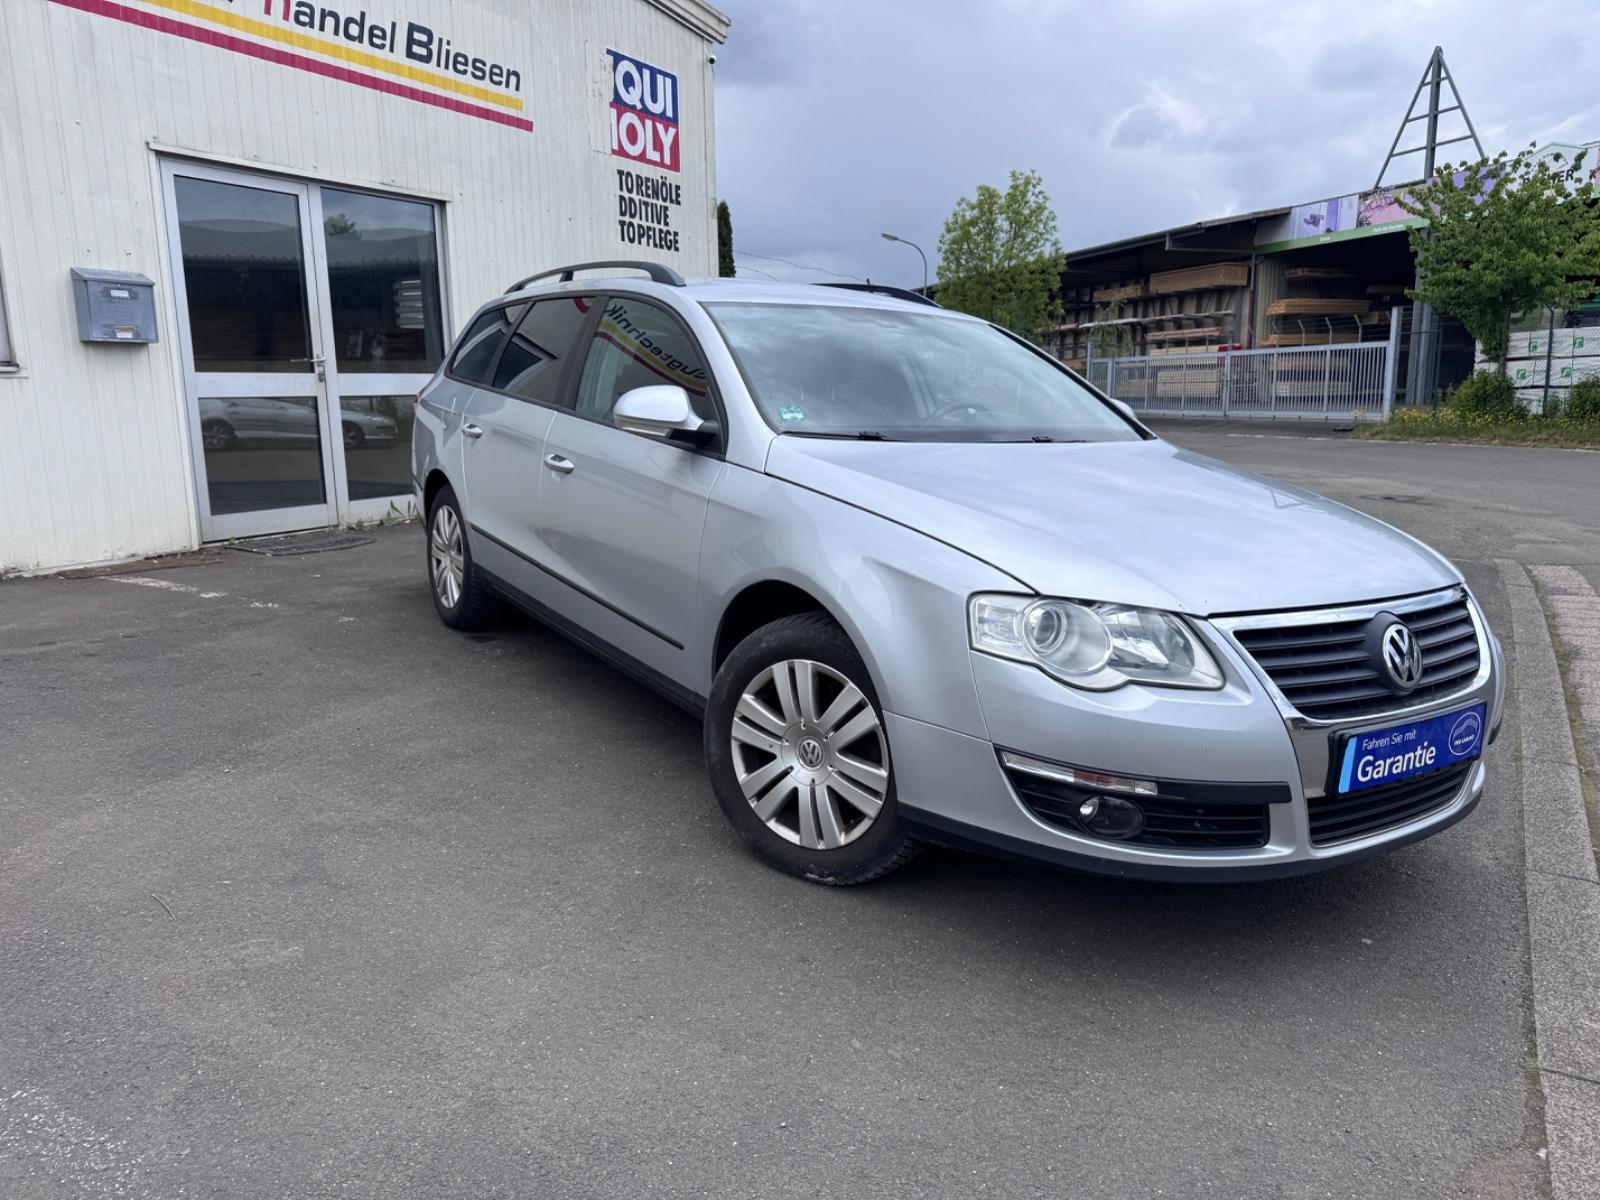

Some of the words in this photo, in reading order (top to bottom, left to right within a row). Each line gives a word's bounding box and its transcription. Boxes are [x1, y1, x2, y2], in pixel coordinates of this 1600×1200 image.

[405, 21, 521, 92] Bliesen
[1384, 625, 1420, 687] VW
[1357, 740, 1437, 783] Garantie
[1361, 737, 1391, 752] Fahren
[1391, 732, 1404, 745] Sie
[1404, 728, 1417, 742] mit
